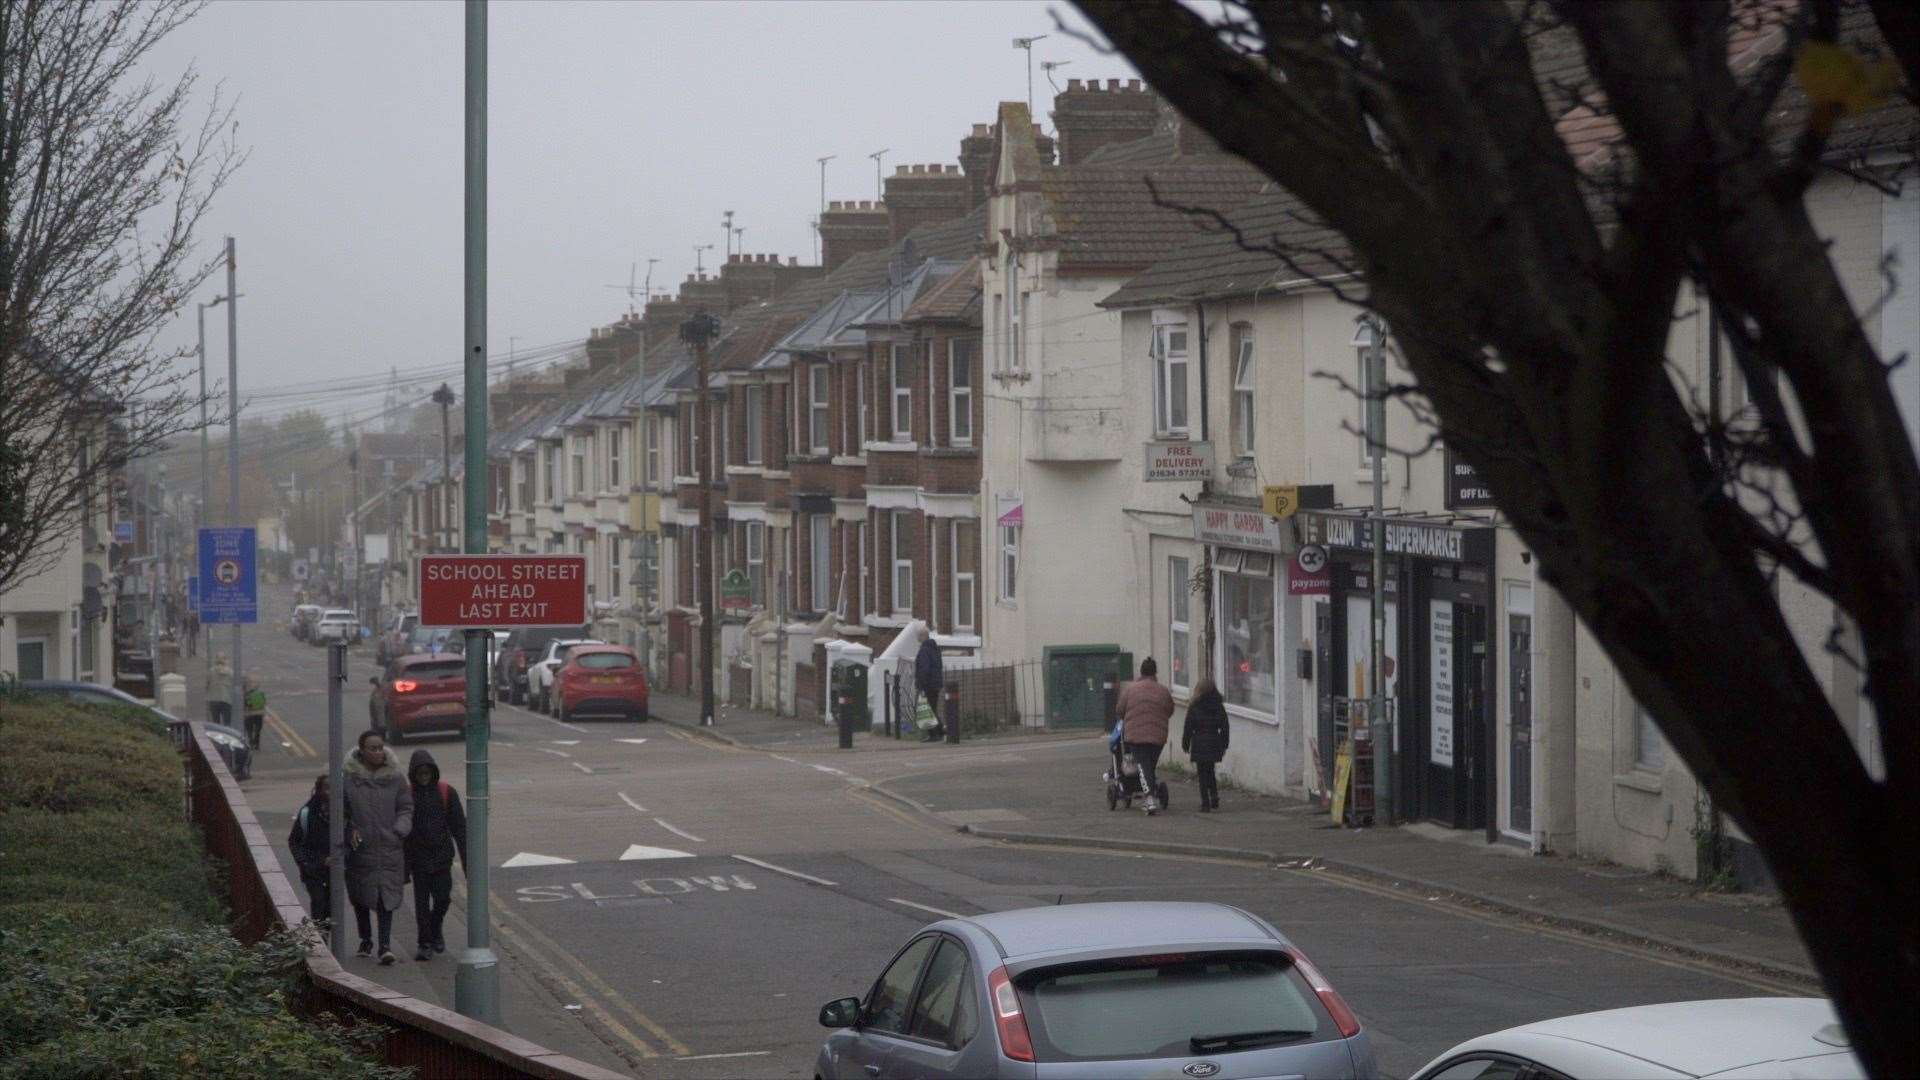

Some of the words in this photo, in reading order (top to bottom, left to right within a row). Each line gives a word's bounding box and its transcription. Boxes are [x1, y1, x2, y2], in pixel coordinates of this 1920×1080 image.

[1167, 447, 1192, 456] FREE
[1155, 457, 1204, 468] DELIVERY
[1460, 488, 1477, 499] OFF
[1206, 511, 1229, 530] HAPPY
[1326, 519, 1355, 547] UZUM
[1385, 524, 1463, 559] SUPERMARKET
[428, 564, 506, 580] SCHOOL
[511, 564, 580, 580] STREET
[471, 583, 536, 599] AHEAD
[459, 602, 503, 618] LAST
[509, 602, 549, 618] EXIT
[516, 874, 757, 903] SLOW
